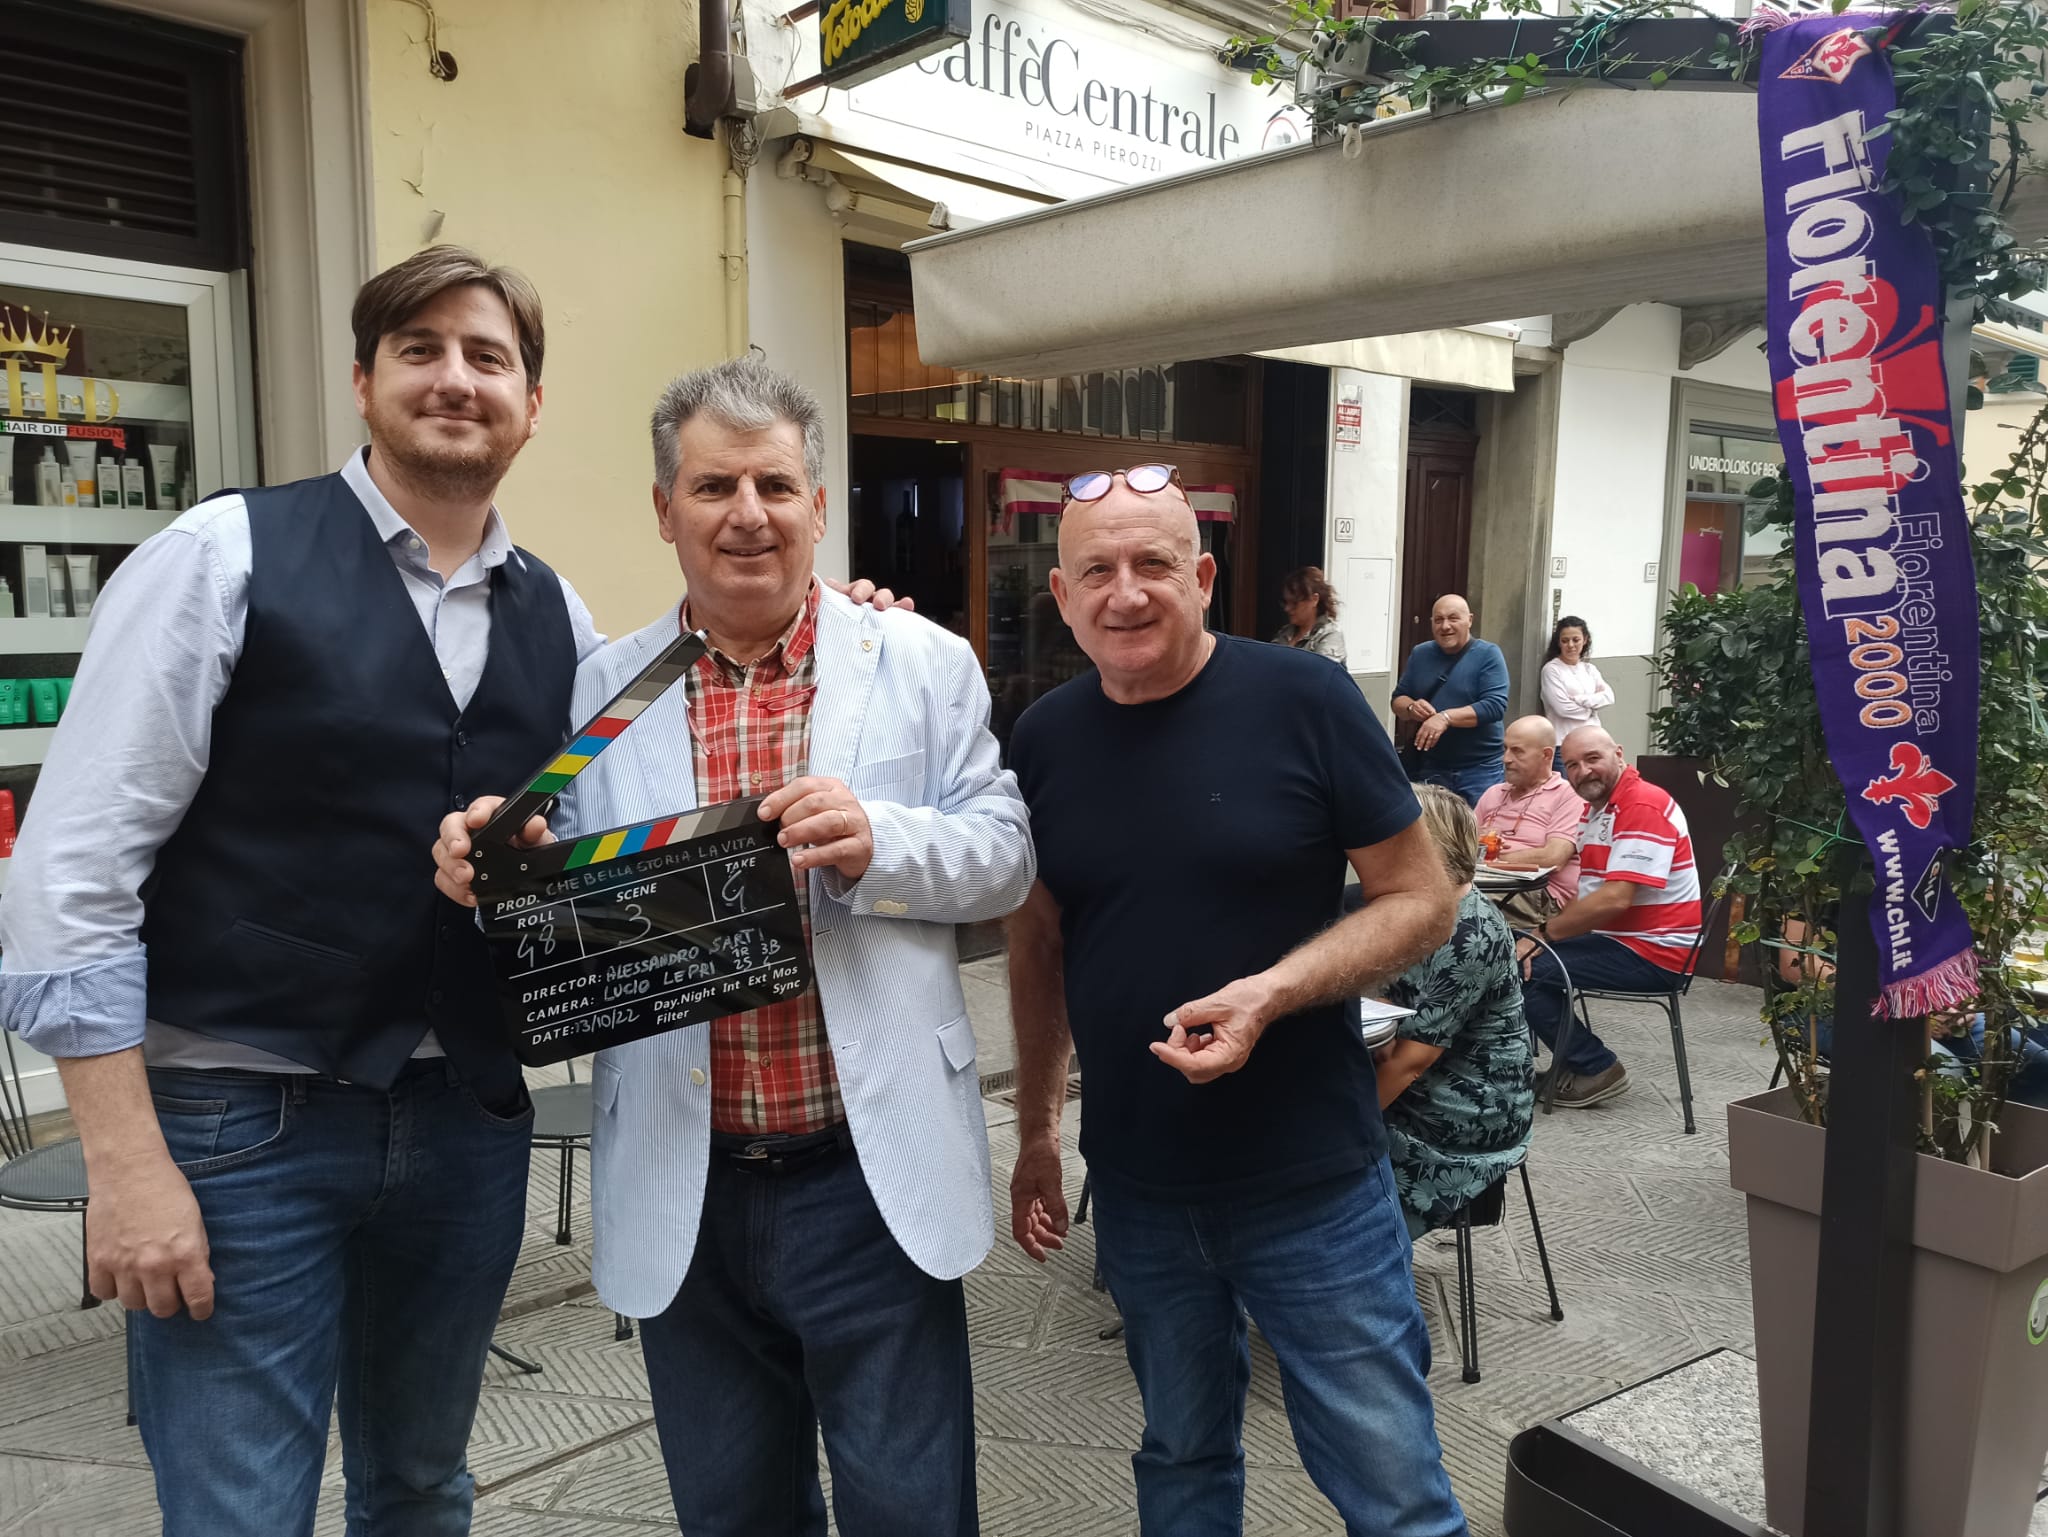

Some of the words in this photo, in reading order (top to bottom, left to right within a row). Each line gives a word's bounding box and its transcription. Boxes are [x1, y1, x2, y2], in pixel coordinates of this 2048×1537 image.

[1025, 121, 1084, 153] PIAZZA
[1093, 141, 1163, 173] PIEROZZI
[1781, 109, 1930, 621] Fiorentina
[0, 420, 38, 433] HAIR
[42, 423, 124, 439] DIFFUSION
[1689, 455, 1750, 474] UNDERCOLORS
[1751, 462, 1763, 476] OF
[1339, 520, 1351, 534] 20
[1555, 559, 1564, 571] 21
[1896, 511, 1953, 737] Fiorentina
[1843, 616, 1913, 730] 2000
[545, 877, 580, 896] CHE
[583, 866, 633, 886] BELLA
[636, 850, 692, 873] STORIA
[721, 836, 756, 853] VITA
[725, 856, 757, 873] TAKE
[496, 894, 540, 914] PROD.
[616, 882, 657, 903] SCENE
[1876, 828, 1913, 972] www.chl.it
[517, 910, 556, 929] ROLL
[618, 903, 652, 946] 3
[516, 923, 556, 969] 48
[606, 945, 700, 983] ALESSANDRO
[709, 928, 764, 955] SARTI
[522, 974, 602, 1004] DIRECTOR:
[603, 979, 650, 1002] LUCIO
[663, 961, 716, 986] LEPRI
[722, 980, 741, 993] Int
[748, 973, 768, 987] Ext
[773, 965, 798, 980] Mos
[526, 996, 595, 1023] CAMERA:
[656, 1009, 690, 1025] Filter
[773, 980, 800, 995] Sync
[532, 1026, 575, 1046] DATE:
